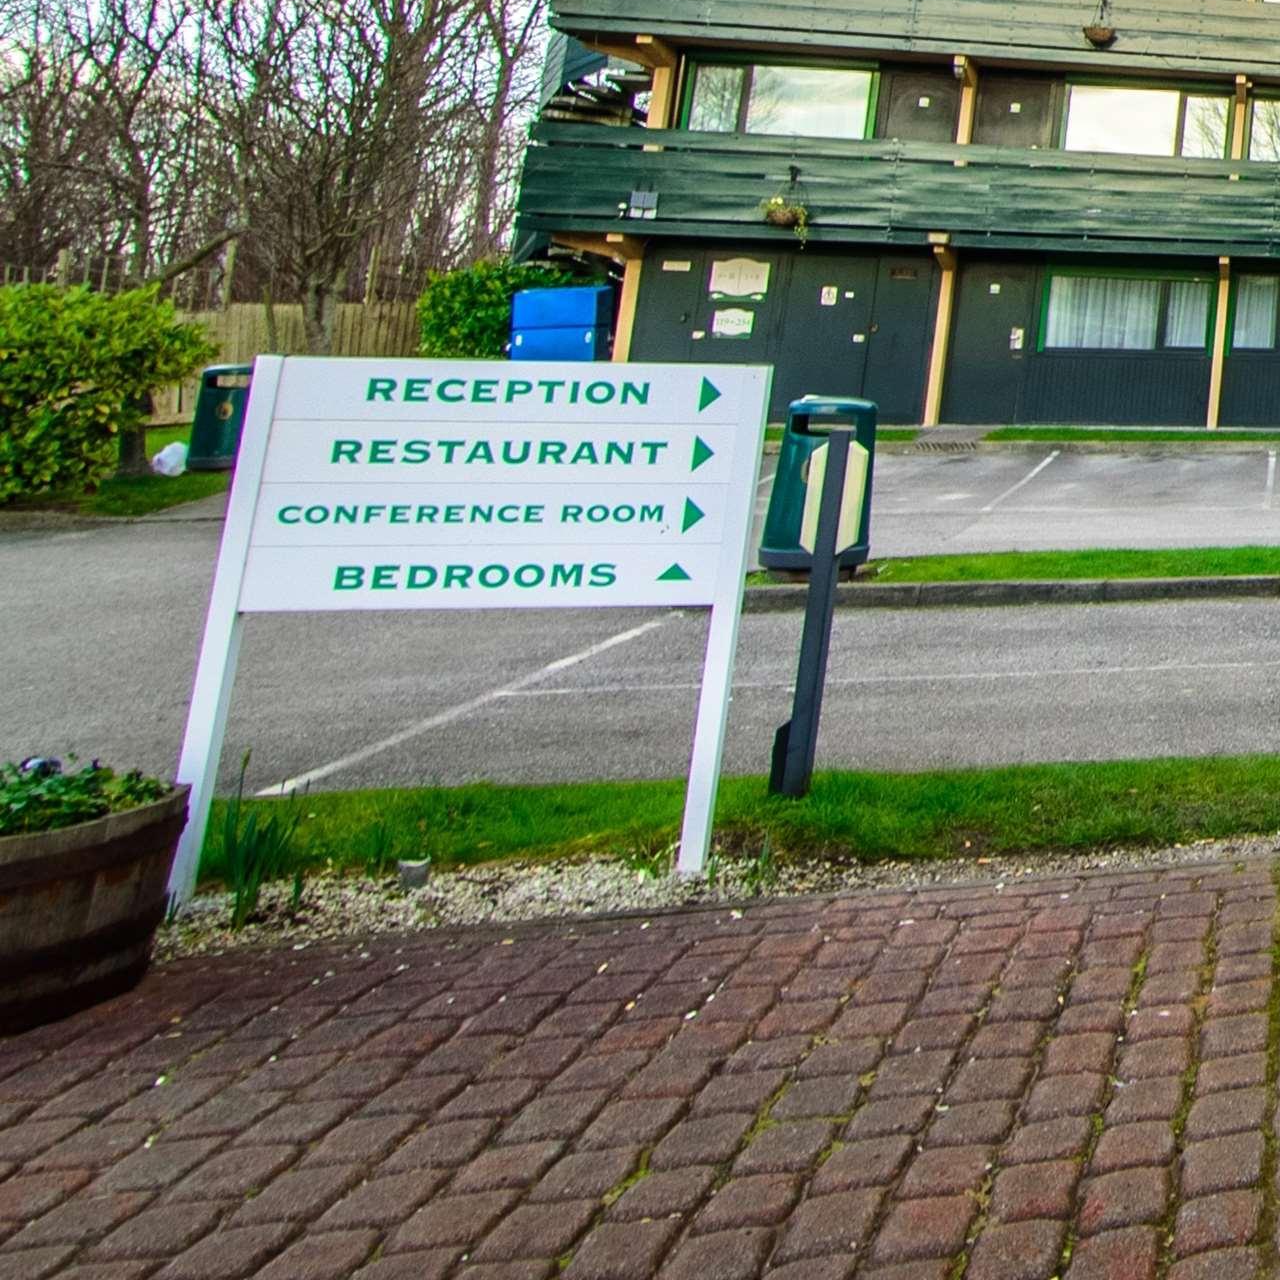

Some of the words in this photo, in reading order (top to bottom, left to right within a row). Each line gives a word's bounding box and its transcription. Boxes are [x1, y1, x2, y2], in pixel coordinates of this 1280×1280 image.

[366, 378, 651, 406] RECEPTION
[331, 440, 669, 466] RESTAURANT
[277, 505, 546, 525] CONFERENCE
[561, 505, 665, 524] ROOM
[334, 564, 617, 591] BEDROOMS
